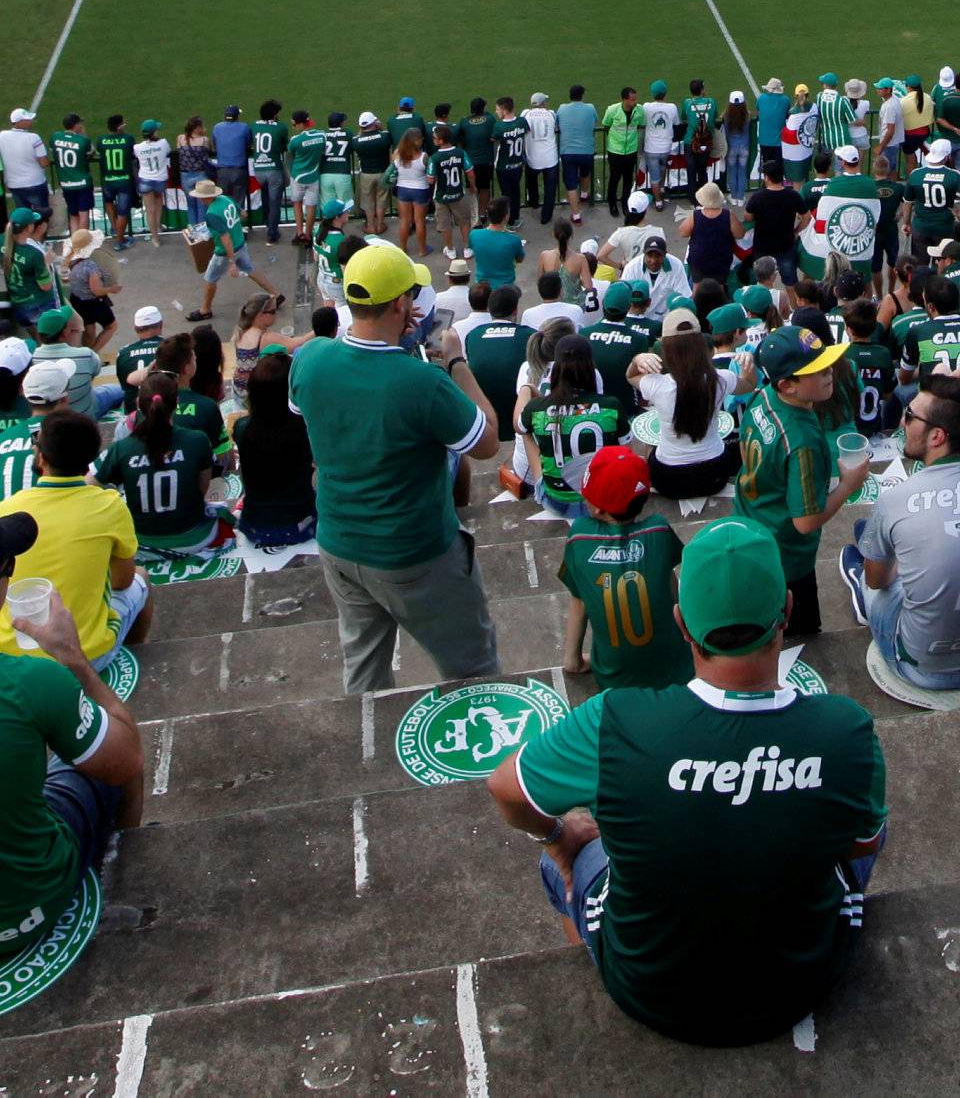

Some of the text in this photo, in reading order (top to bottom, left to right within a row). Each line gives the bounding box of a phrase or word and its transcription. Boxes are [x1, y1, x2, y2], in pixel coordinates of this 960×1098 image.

[255, 132, 273, 153] 10
[325, 141, 349, 156] 27
[55, 147, 78, 168] 10
[105, 148, 124, 171] 10
[922, 183, 947, 208] 10
[589, 331, 632, 345] crefisa
[546, 420, 604, 468] 10
[136, 469, 178, 514] 10
[595, 570, 653, 647] 10
[470, 694, 497, 705] 1973
[401, 702, 431, 772] DE FUTEBOL
[668, 745, 824, 806] crefisa
